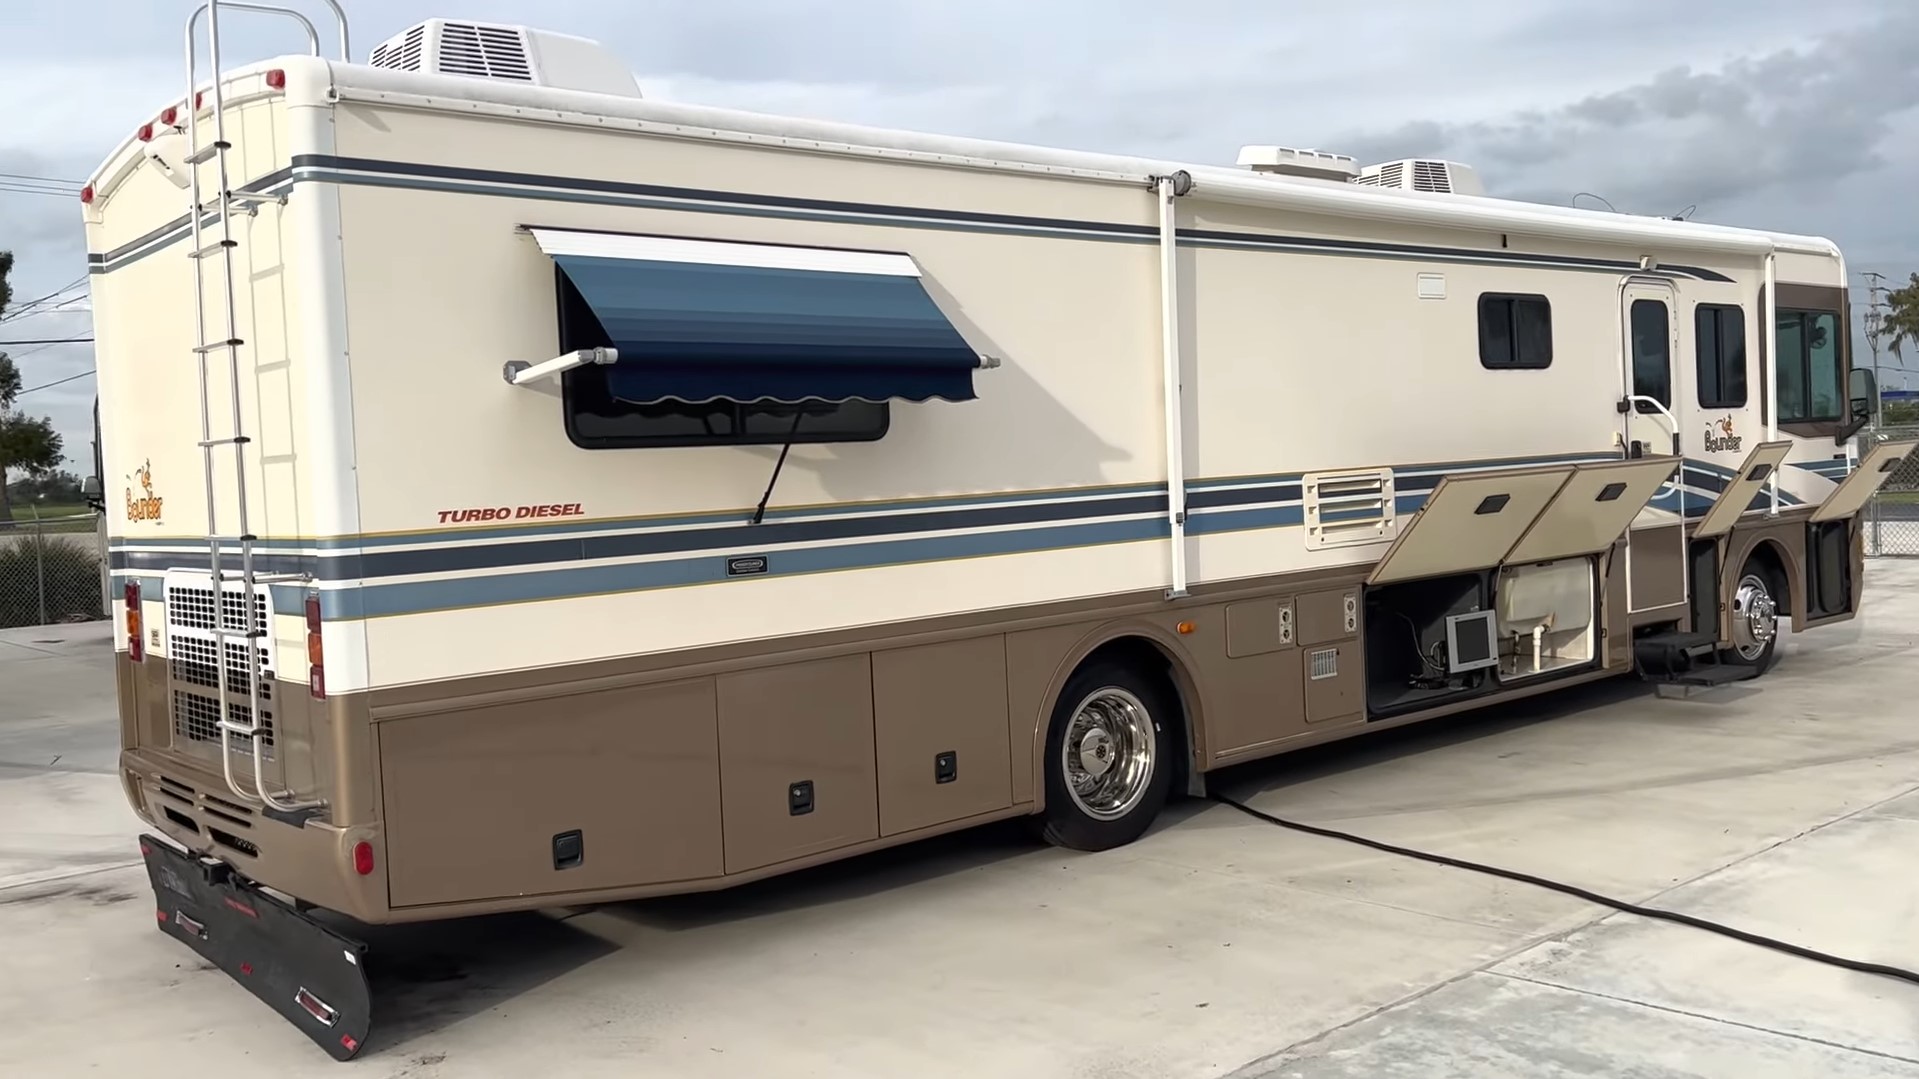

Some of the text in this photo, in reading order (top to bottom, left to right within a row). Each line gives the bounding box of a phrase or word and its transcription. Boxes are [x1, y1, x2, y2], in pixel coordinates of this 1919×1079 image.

[1704, 429, 1742, 453] Bounder
[126, 487, 163, 523] Bounder
[438, 503, 585, 523] TURBO DIESEL
